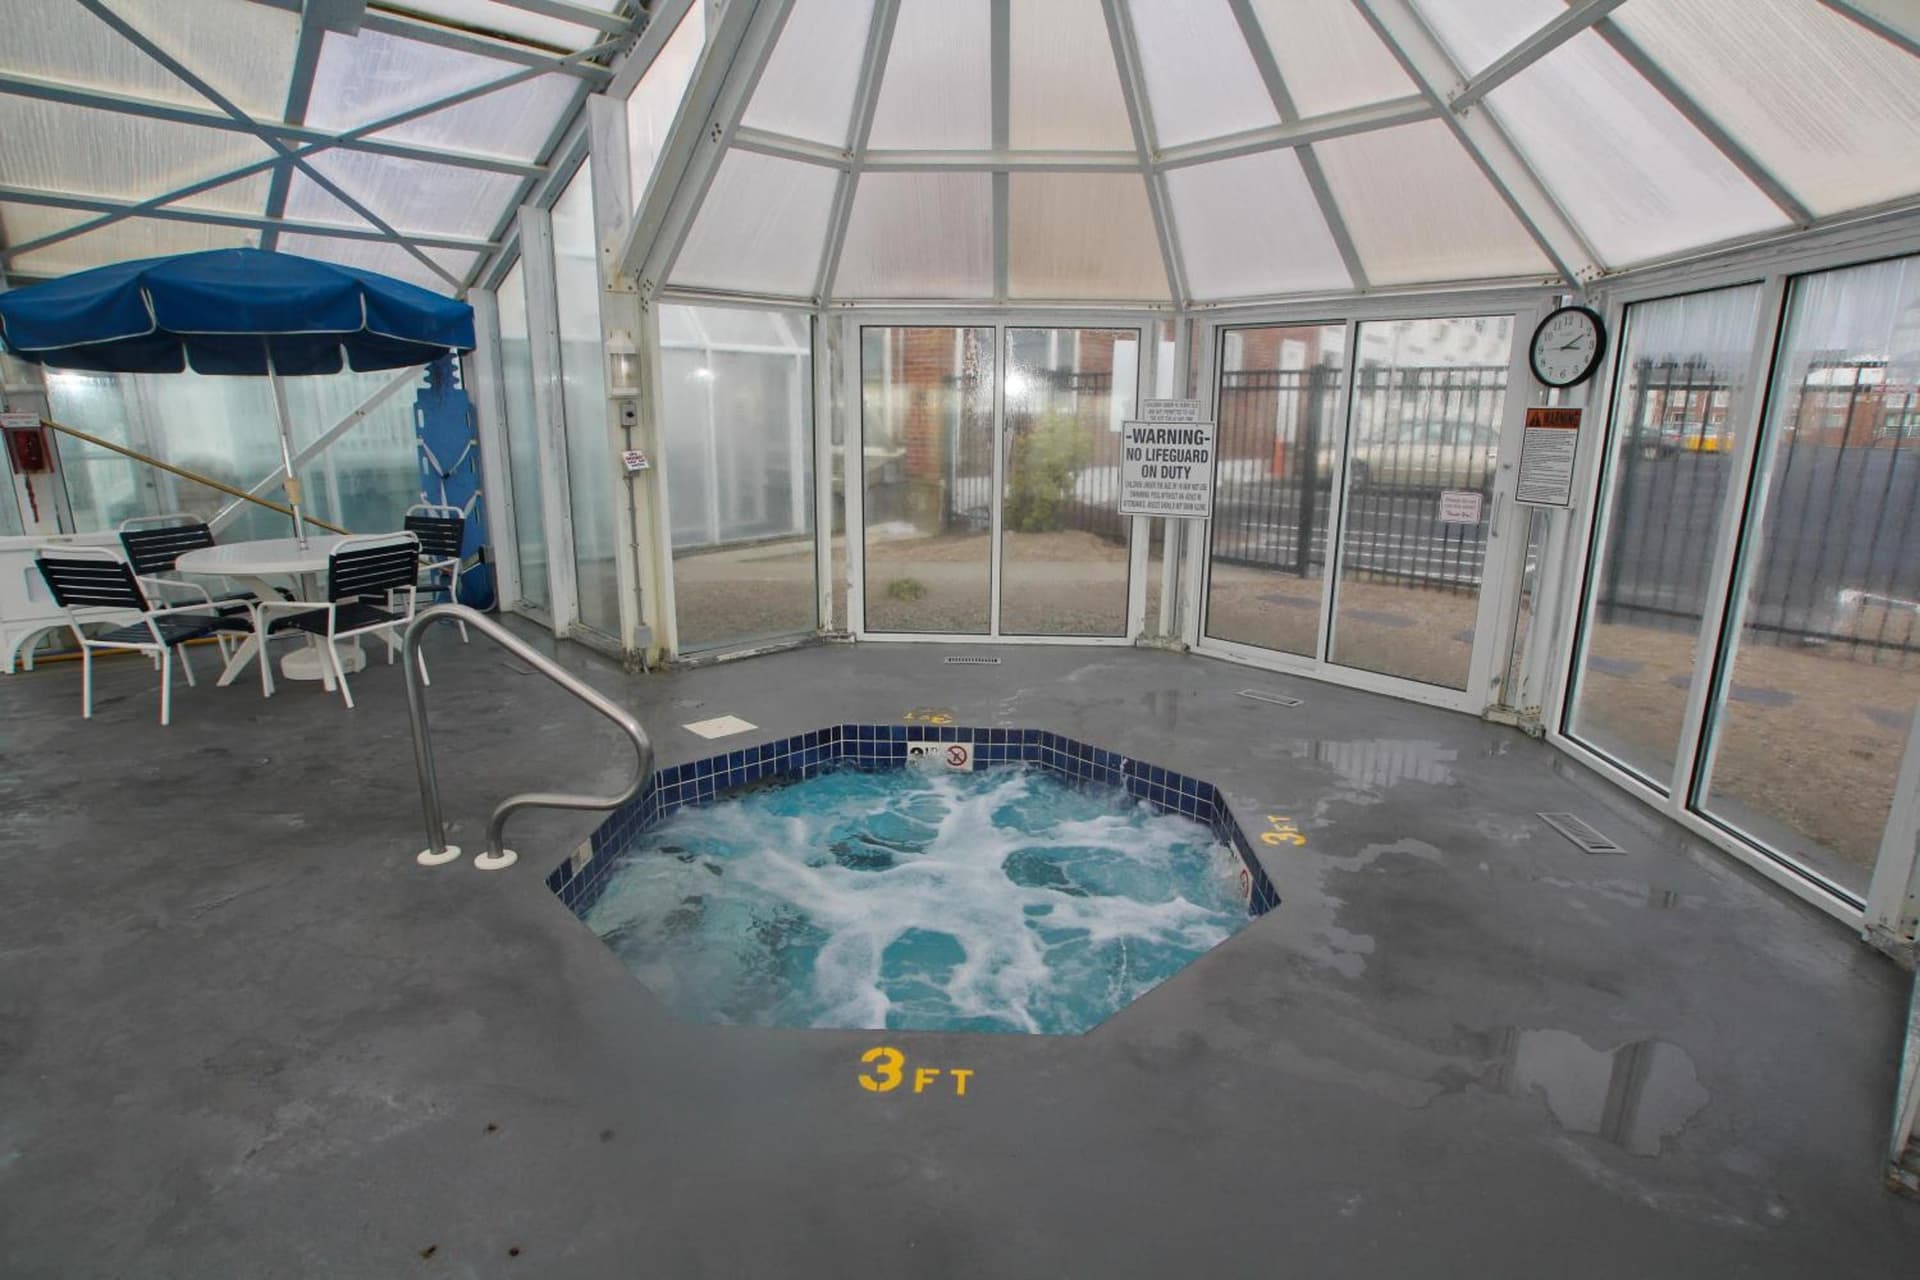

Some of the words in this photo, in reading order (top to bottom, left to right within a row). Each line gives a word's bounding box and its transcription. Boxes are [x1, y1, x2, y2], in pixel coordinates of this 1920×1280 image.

[1126, 447, 1142, 461] NO
[1145, 447, 1208, 463] LIFEGUARD
[1141, 464, 1157, 478] ON
[1160, 465, 1191, 479] DUTY
[858, 1046, 904, 1092] 3
[914, 1068, 974, 1095] FT
